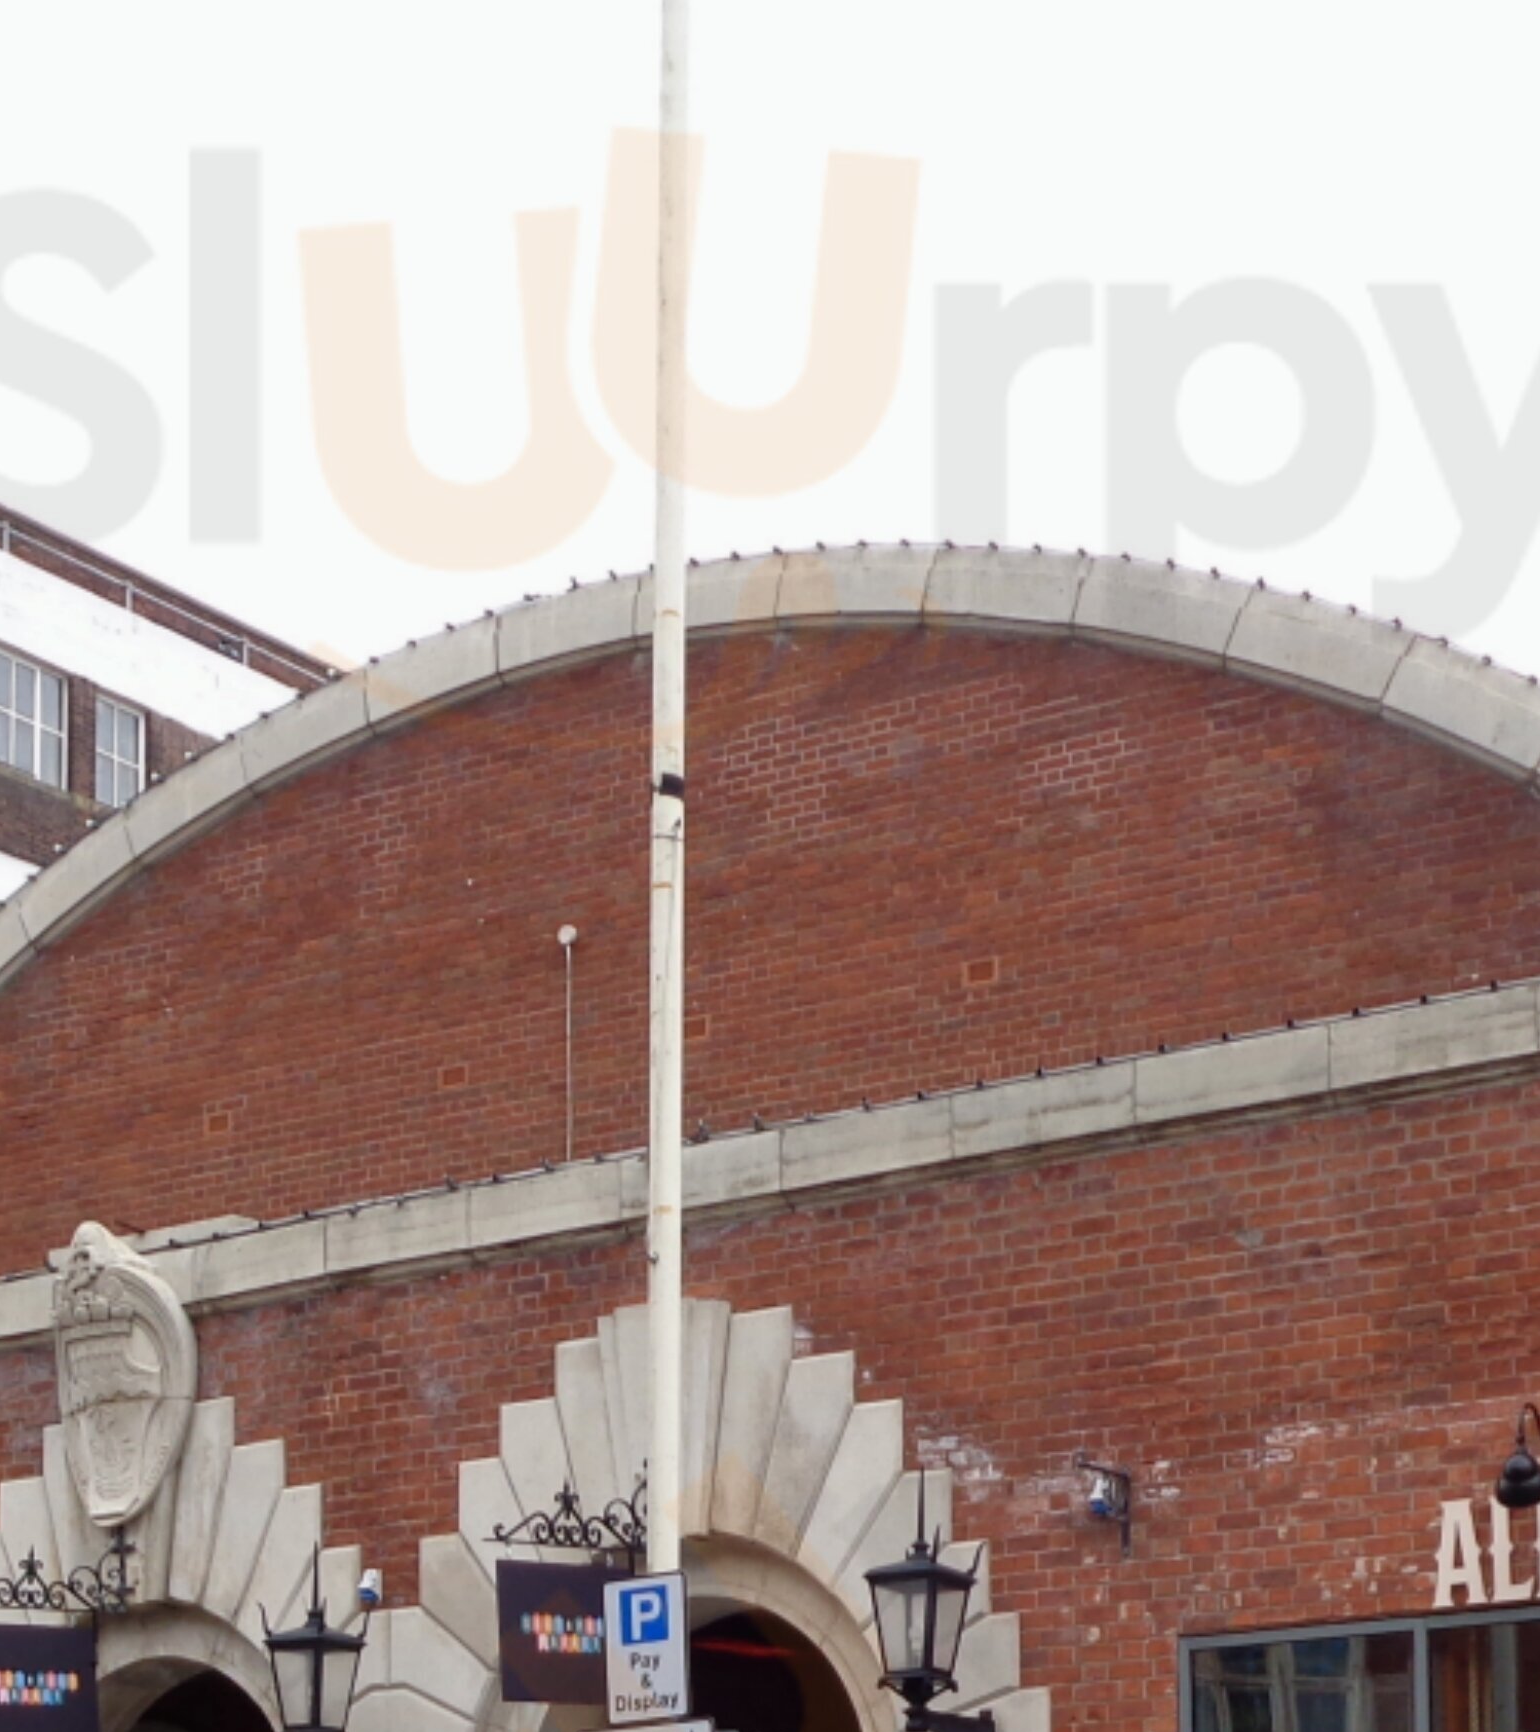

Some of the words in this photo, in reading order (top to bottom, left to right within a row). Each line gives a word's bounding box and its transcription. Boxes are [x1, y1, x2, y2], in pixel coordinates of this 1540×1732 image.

[631, 1592, 660, 1640] P
[630, 1652, 660, 1671] Pay
[641, 1673, 651, 1689] &
[615, 1693, 678, 1712] Display
